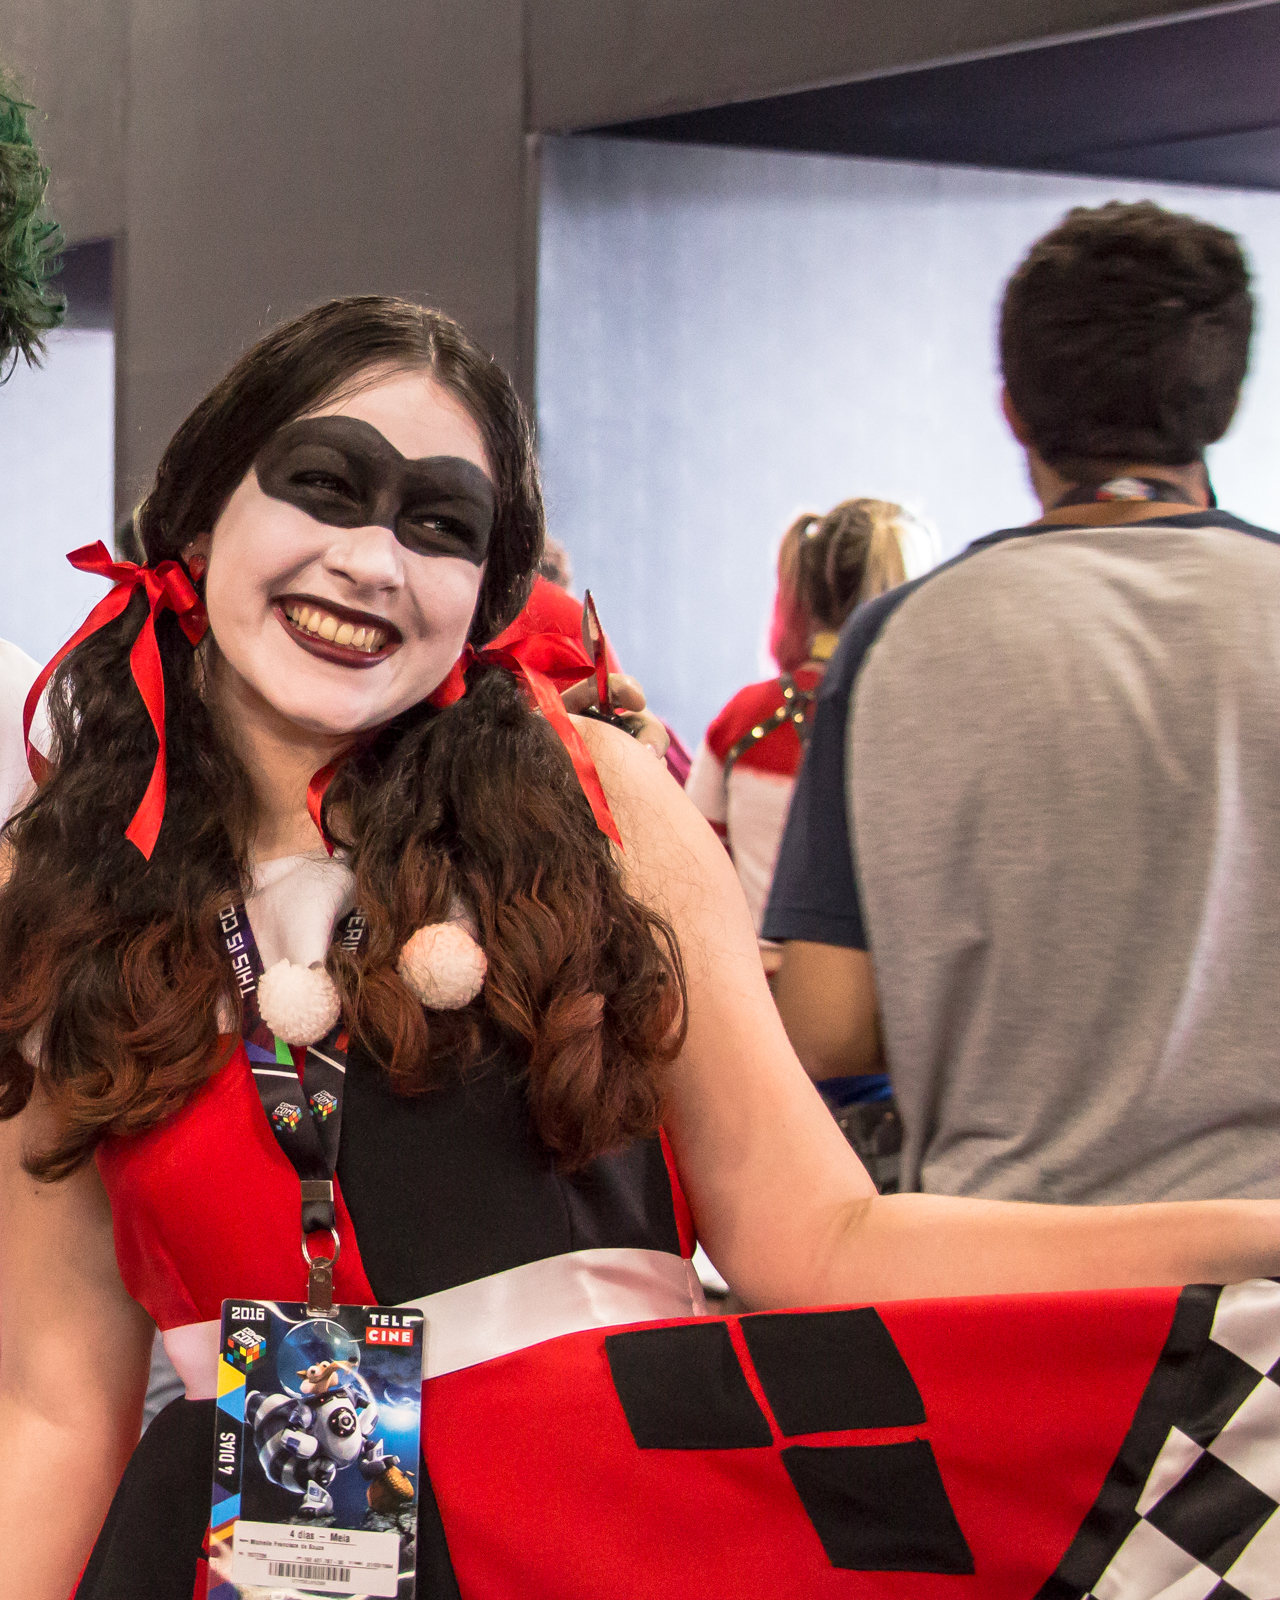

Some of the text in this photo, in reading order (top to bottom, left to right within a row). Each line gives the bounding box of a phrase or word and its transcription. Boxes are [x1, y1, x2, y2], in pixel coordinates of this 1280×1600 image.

[225, 931, 245, 954] IS
[232, 953, 256, 999] THIS
[313, 1092, 331, 1104] CON
[274, 1105, 295, 1116] CON
[231, 1306, 265, 1321] 2016
[369, 1313, 411, 1327] TELE
[232, 1330, 259, 1348] CON
[368, 1329, 411, 1343] CINE
[218, 1432, 236, 1475] 4 DIAS
[289, 1529, 295, 1538] 4
[297, 1530, 315, 1540] dias
